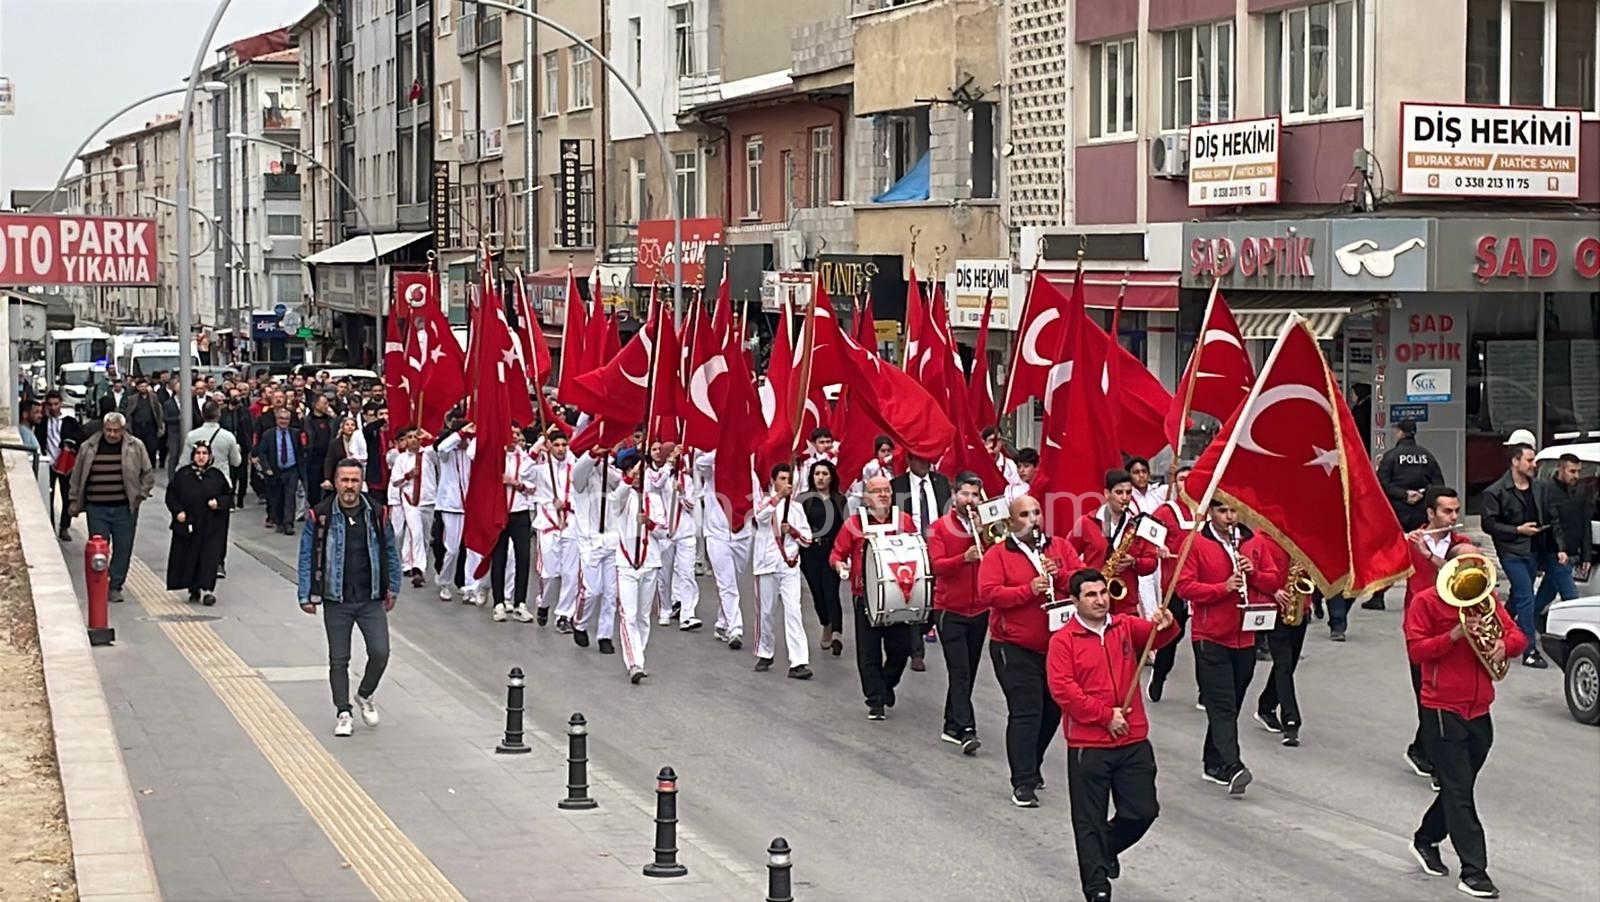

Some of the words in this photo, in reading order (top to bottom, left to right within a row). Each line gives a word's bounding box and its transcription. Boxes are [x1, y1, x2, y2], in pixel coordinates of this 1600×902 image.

[1195, 129, 1218, 162] DİŞ
[1222, 123, 1275, 156] HEKİMİ
[1414, 110, 1462, 148] DİŞ
[1471, 114, 1571, 147] HEKİMİ
[1414, 155, 1452, 167] BURAK
[1453, 156, 1485, 168] SAYIN
[1500, 155, 1537, 169] HATİCE
[1539, 158, 1570, 170] SAYIN
[1455, 177, 1462, 187] 0
[1465, 177, 1484, 188] 338
[1487, 177, 1503, 188] 213
[1506, 178, 1515, 189] 11
[1517, 178, 1530, 190] 75
[60, 219, 149, 256] PARK
[1240, 226, 1315, 277] OPTİK
[62, 255, 150, 282] YIKAMA
[956, 264, 972, 292] DİŞ
[974, 263, 1009, 289] HEKİMİ
[1396, 336, 1461, 363] OPTİK
[1415, 378, 1436, 391] SGK
